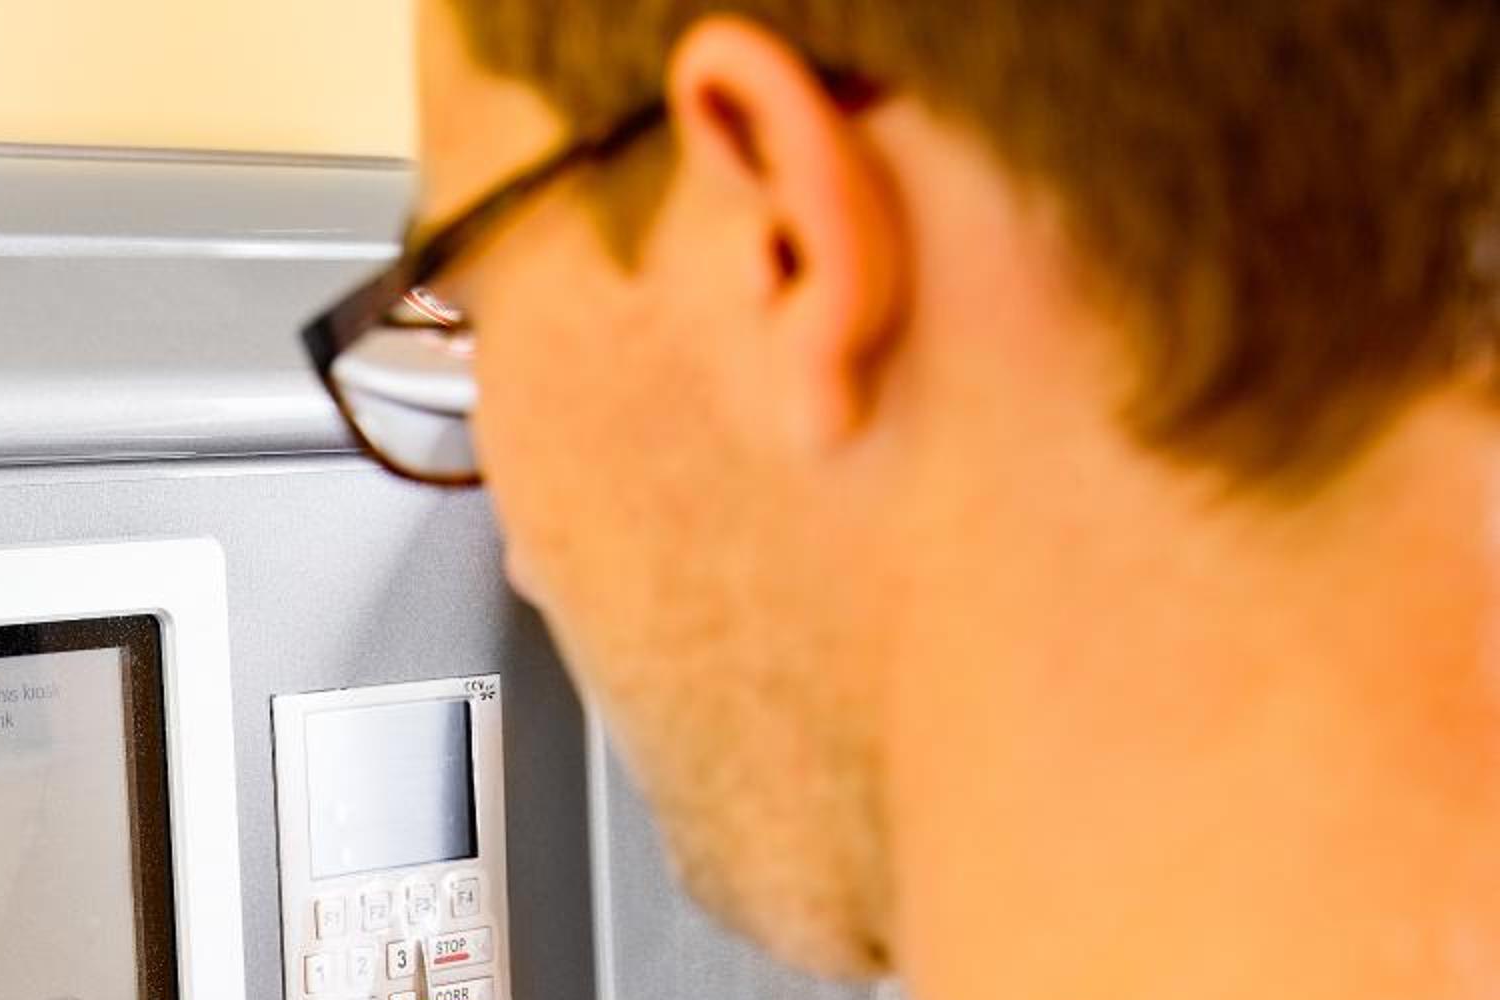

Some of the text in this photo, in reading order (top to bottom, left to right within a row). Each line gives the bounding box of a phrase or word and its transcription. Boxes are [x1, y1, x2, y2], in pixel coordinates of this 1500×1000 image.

[22, 681, 61, 701] kio
[435, 936, 467, 955] STOP
[397, 949, 407, 969] 3
